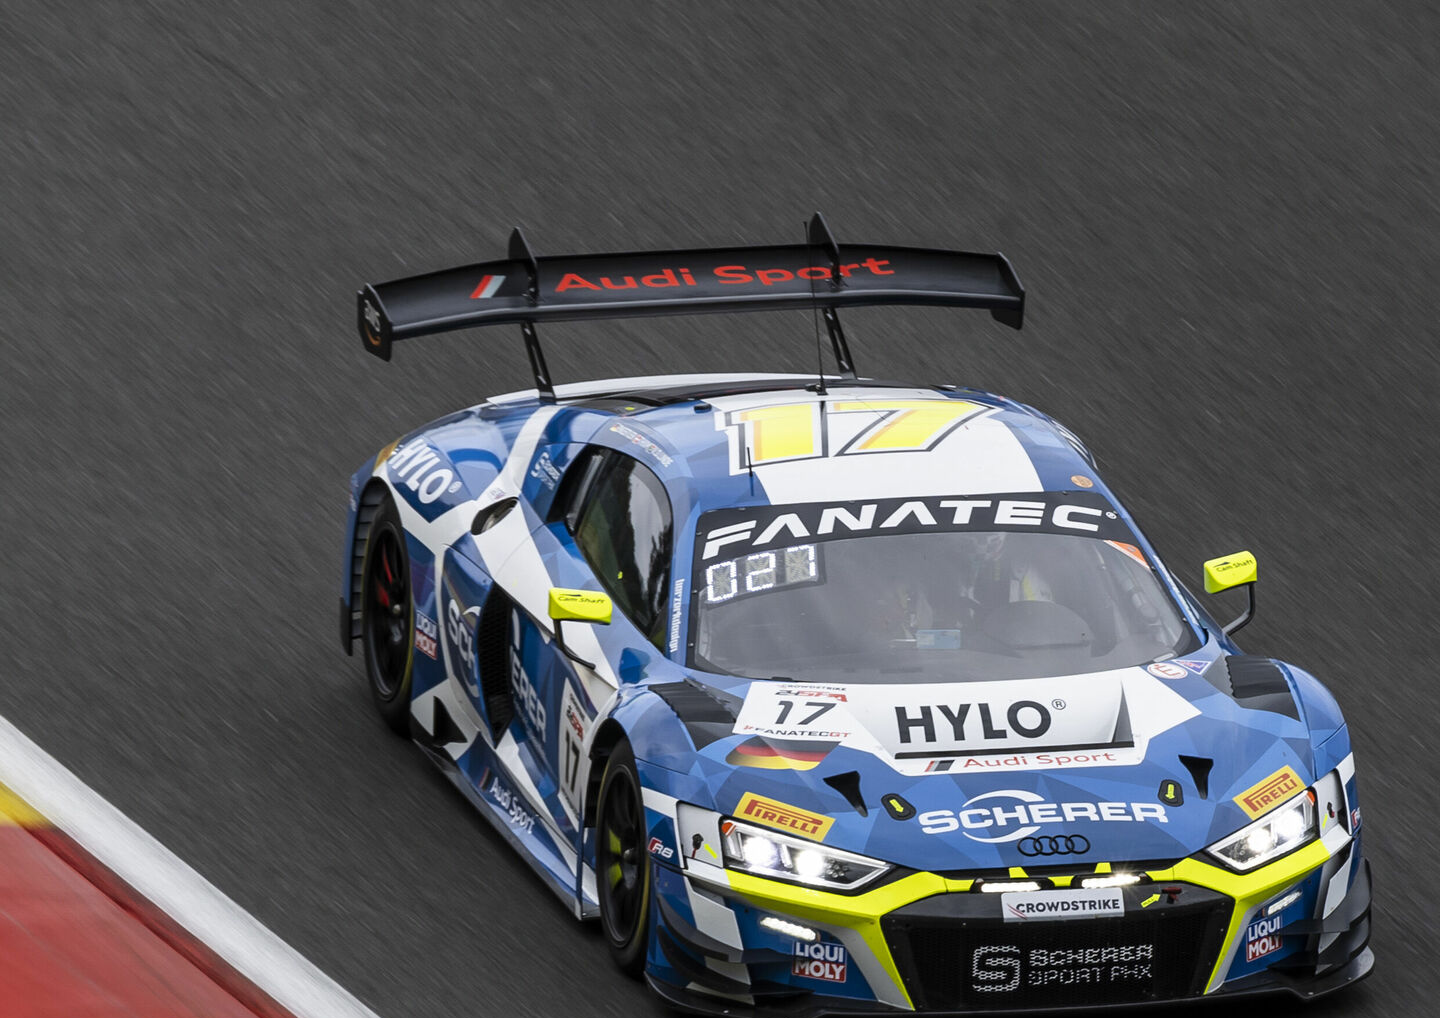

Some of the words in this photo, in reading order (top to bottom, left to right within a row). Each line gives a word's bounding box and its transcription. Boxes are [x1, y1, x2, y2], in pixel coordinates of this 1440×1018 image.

[555, 267, 698, 292] Audi
[713, 257, 896, 286] Sport
[723, 399, 997, 470] 17
[701, 500, 1102, 561] FANATEC
[706, 544, 816, 602] 027
[775, 700, 837, 726] 17
[963, 753, 1028, 769] Audi
[1036, 750, 1118, 767] Sport
[489, 776, 511, 809] Audi
[1242, 772, 1298, 813] PIRELLI
[743, 799, 824, 835] PIRELLI
[917, 800, 1169, 835] SCHERER
[1015, 898, 1121, 914] CROWDSTRIKE
[1248, 916, 1281, 942] LIQUI
[795, 942, 845, 963] LIQUI
[1029, 944, 1154, 968] SCHERER
[1248, 936, 1281, 960] MOLY
[795, 960, 845, 980] MOLY
[1028, 967, 1105, 986] SPORT
